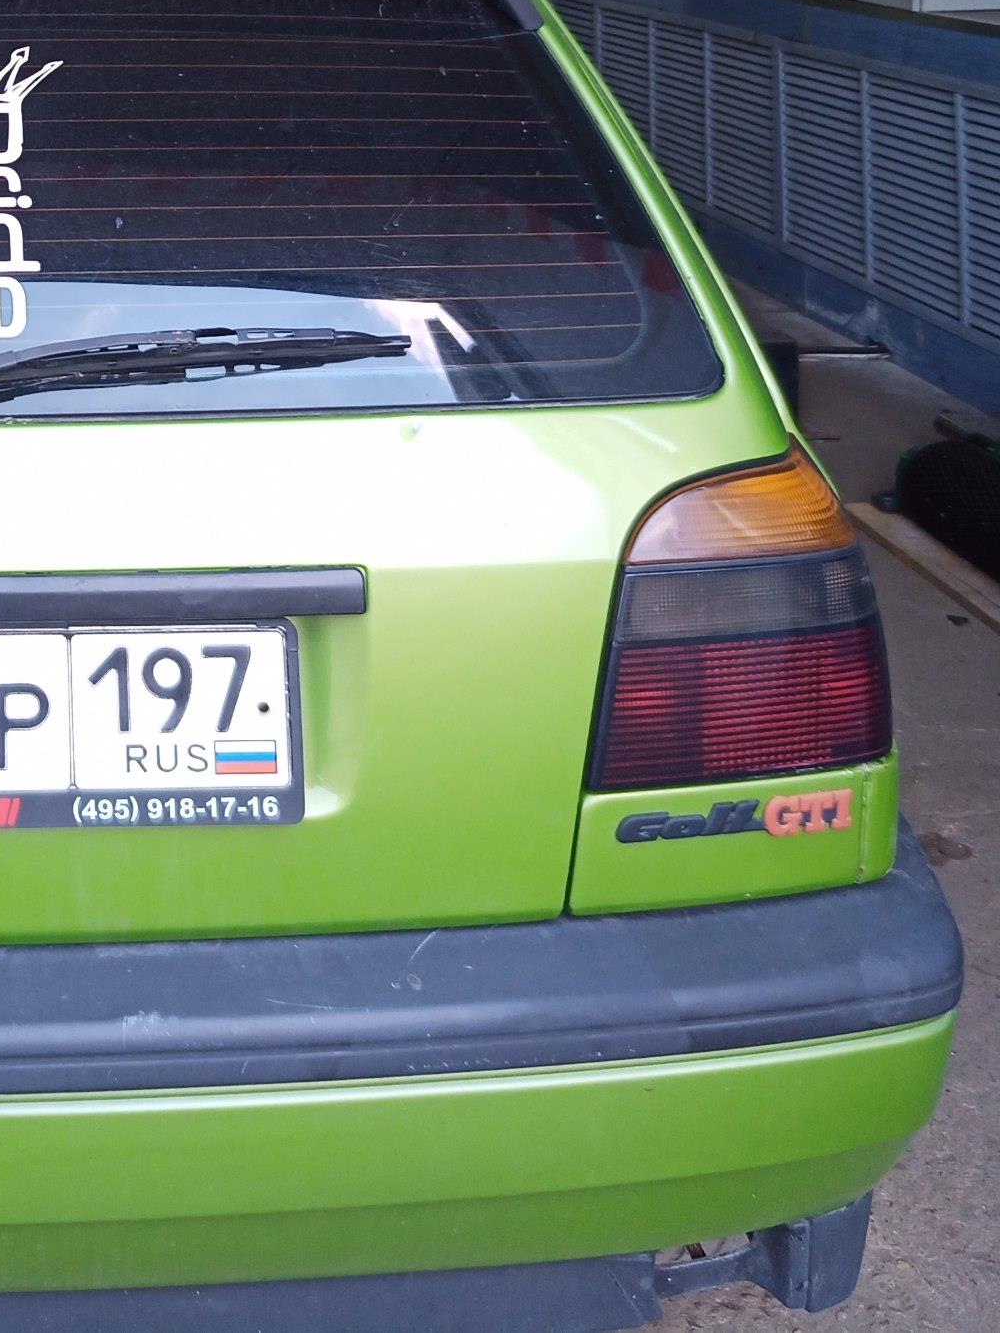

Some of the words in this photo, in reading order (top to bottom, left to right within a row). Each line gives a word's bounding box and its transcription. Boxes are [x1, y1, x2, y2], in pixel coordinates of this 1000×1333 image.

[88, 643, 252, 734] 197
[126, 743, 210, 774] RUS
[72, 795, 140, 823] (495)
[147, 795, 280, 821] 918-17-16
[763, 788, 853, 838] GTI
